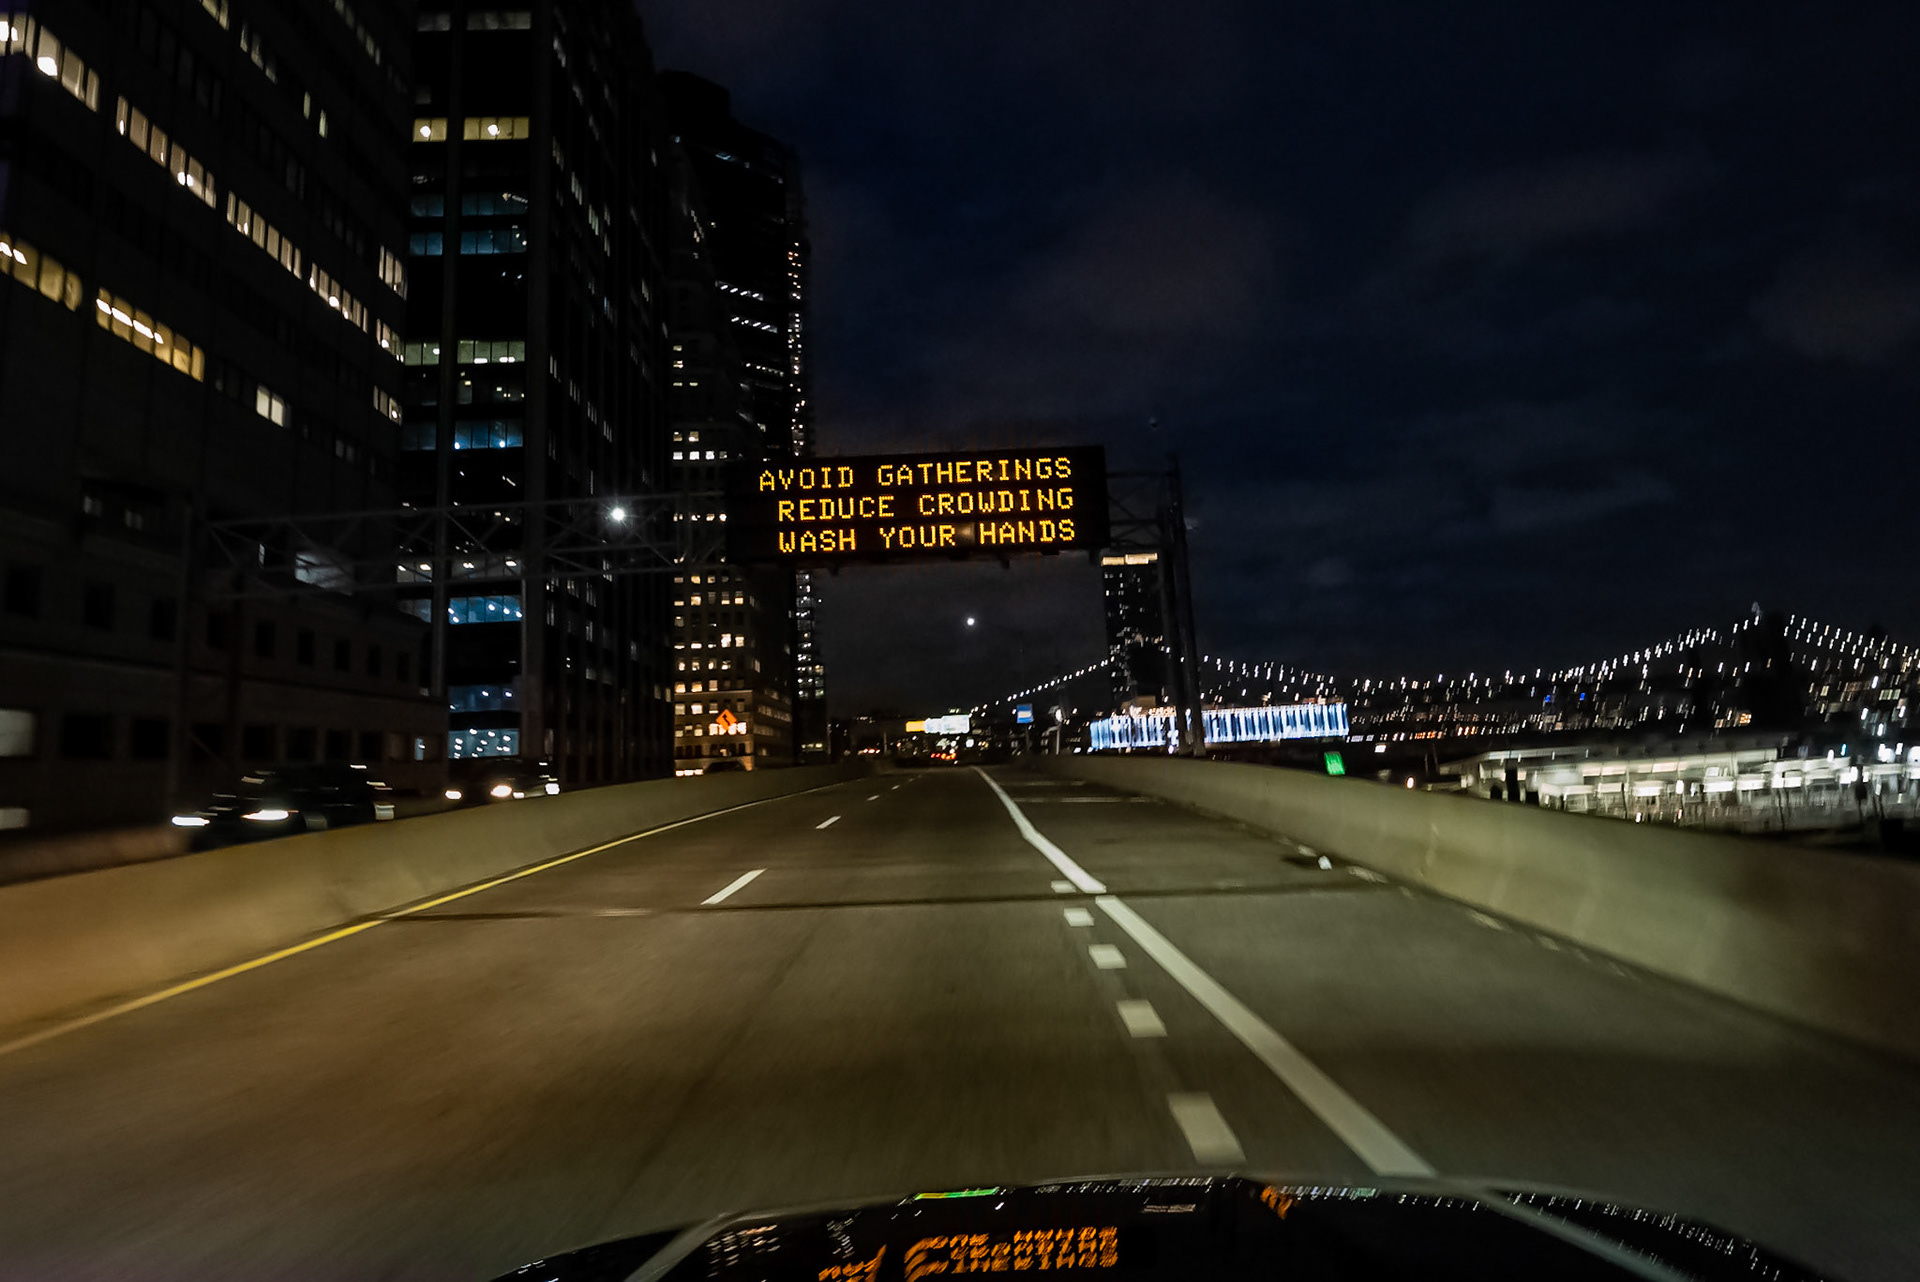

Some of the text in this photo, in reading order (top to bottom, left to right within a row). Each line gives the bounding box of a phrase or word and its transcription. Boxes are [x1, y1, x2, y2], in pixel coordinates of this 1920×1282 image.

[760, 457, 1071, 491] AVOID GATHERINGS
[779, 488, 1073, 521] REDUCE CROWDING
[779, 519, 1075, 553] WASH YOUR HANDS
